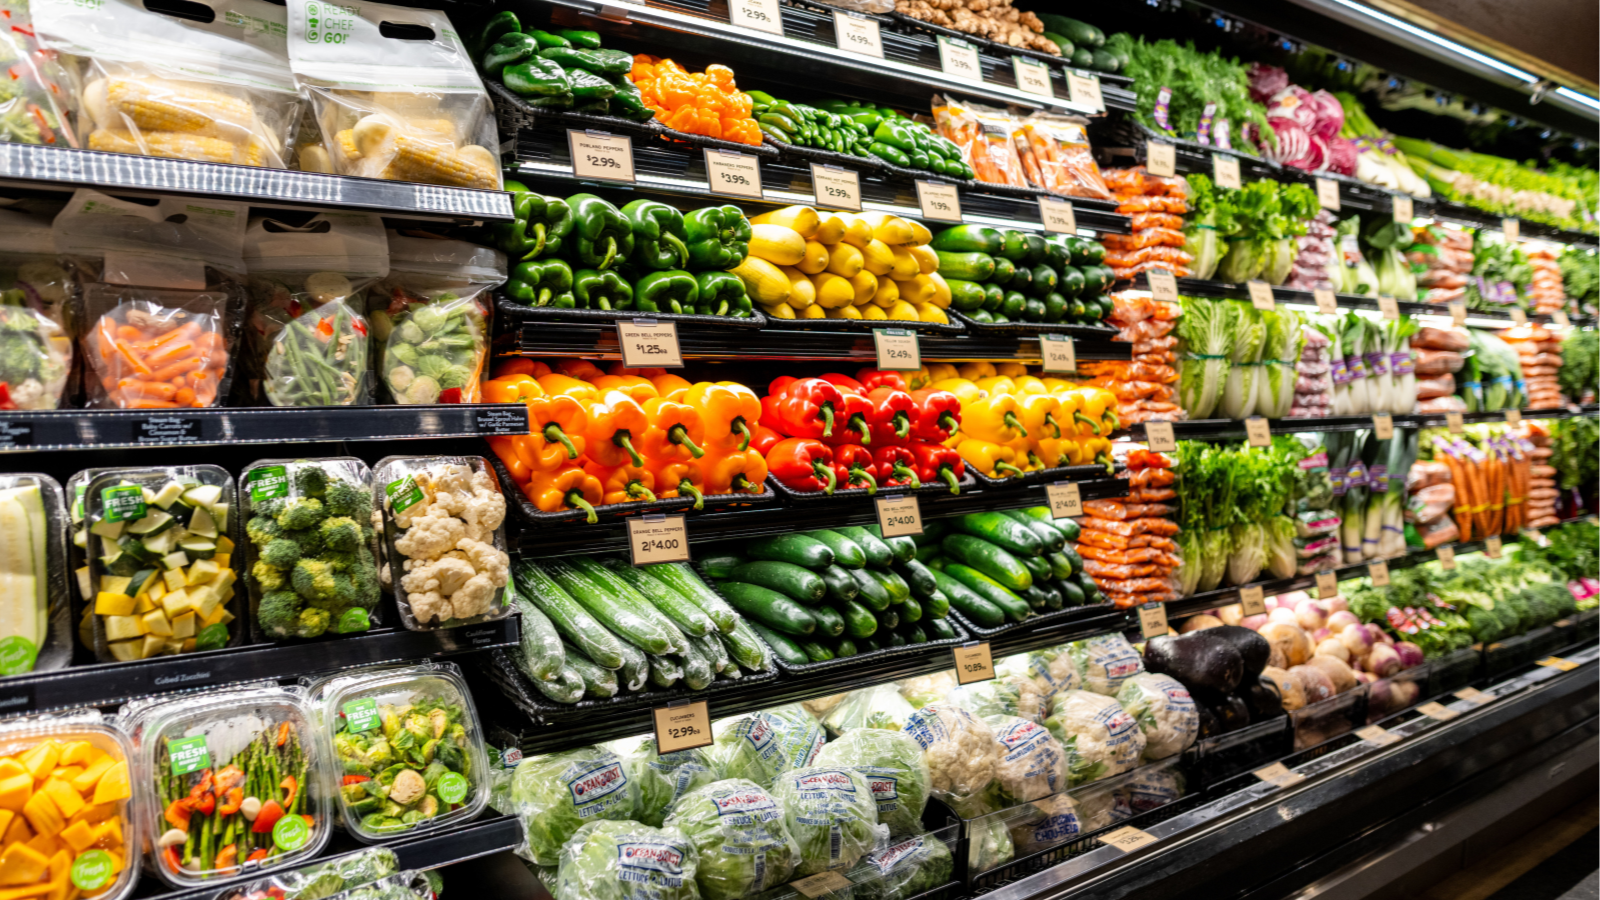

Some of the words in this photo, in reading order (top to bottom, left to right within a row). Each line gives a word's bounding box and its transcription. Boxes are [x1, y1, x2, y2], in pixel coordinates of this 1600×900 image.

[586, 155, 621, 169] $2.99lb
[636, 344, 668, 354] $1.25ea
[251, 475, 286, 488] FRESH
[104, 495, 144, 509] FRESH
[641, 539, 679, 553] 2/$4.00
[347, 708, 377, 722] FRESH
[670, 713, 695, 722] CUCUMBERS
[668, 726, 701, 739] $2.99ea
[170, 745, 208, 763] FRESH
[579, 803, 606, 818] LETTUCE
[625, 847, 655, 859] OCEAN
[619, 870, 650, 885] LETTUCE
[660, 877, 683, 888] LAITUE
